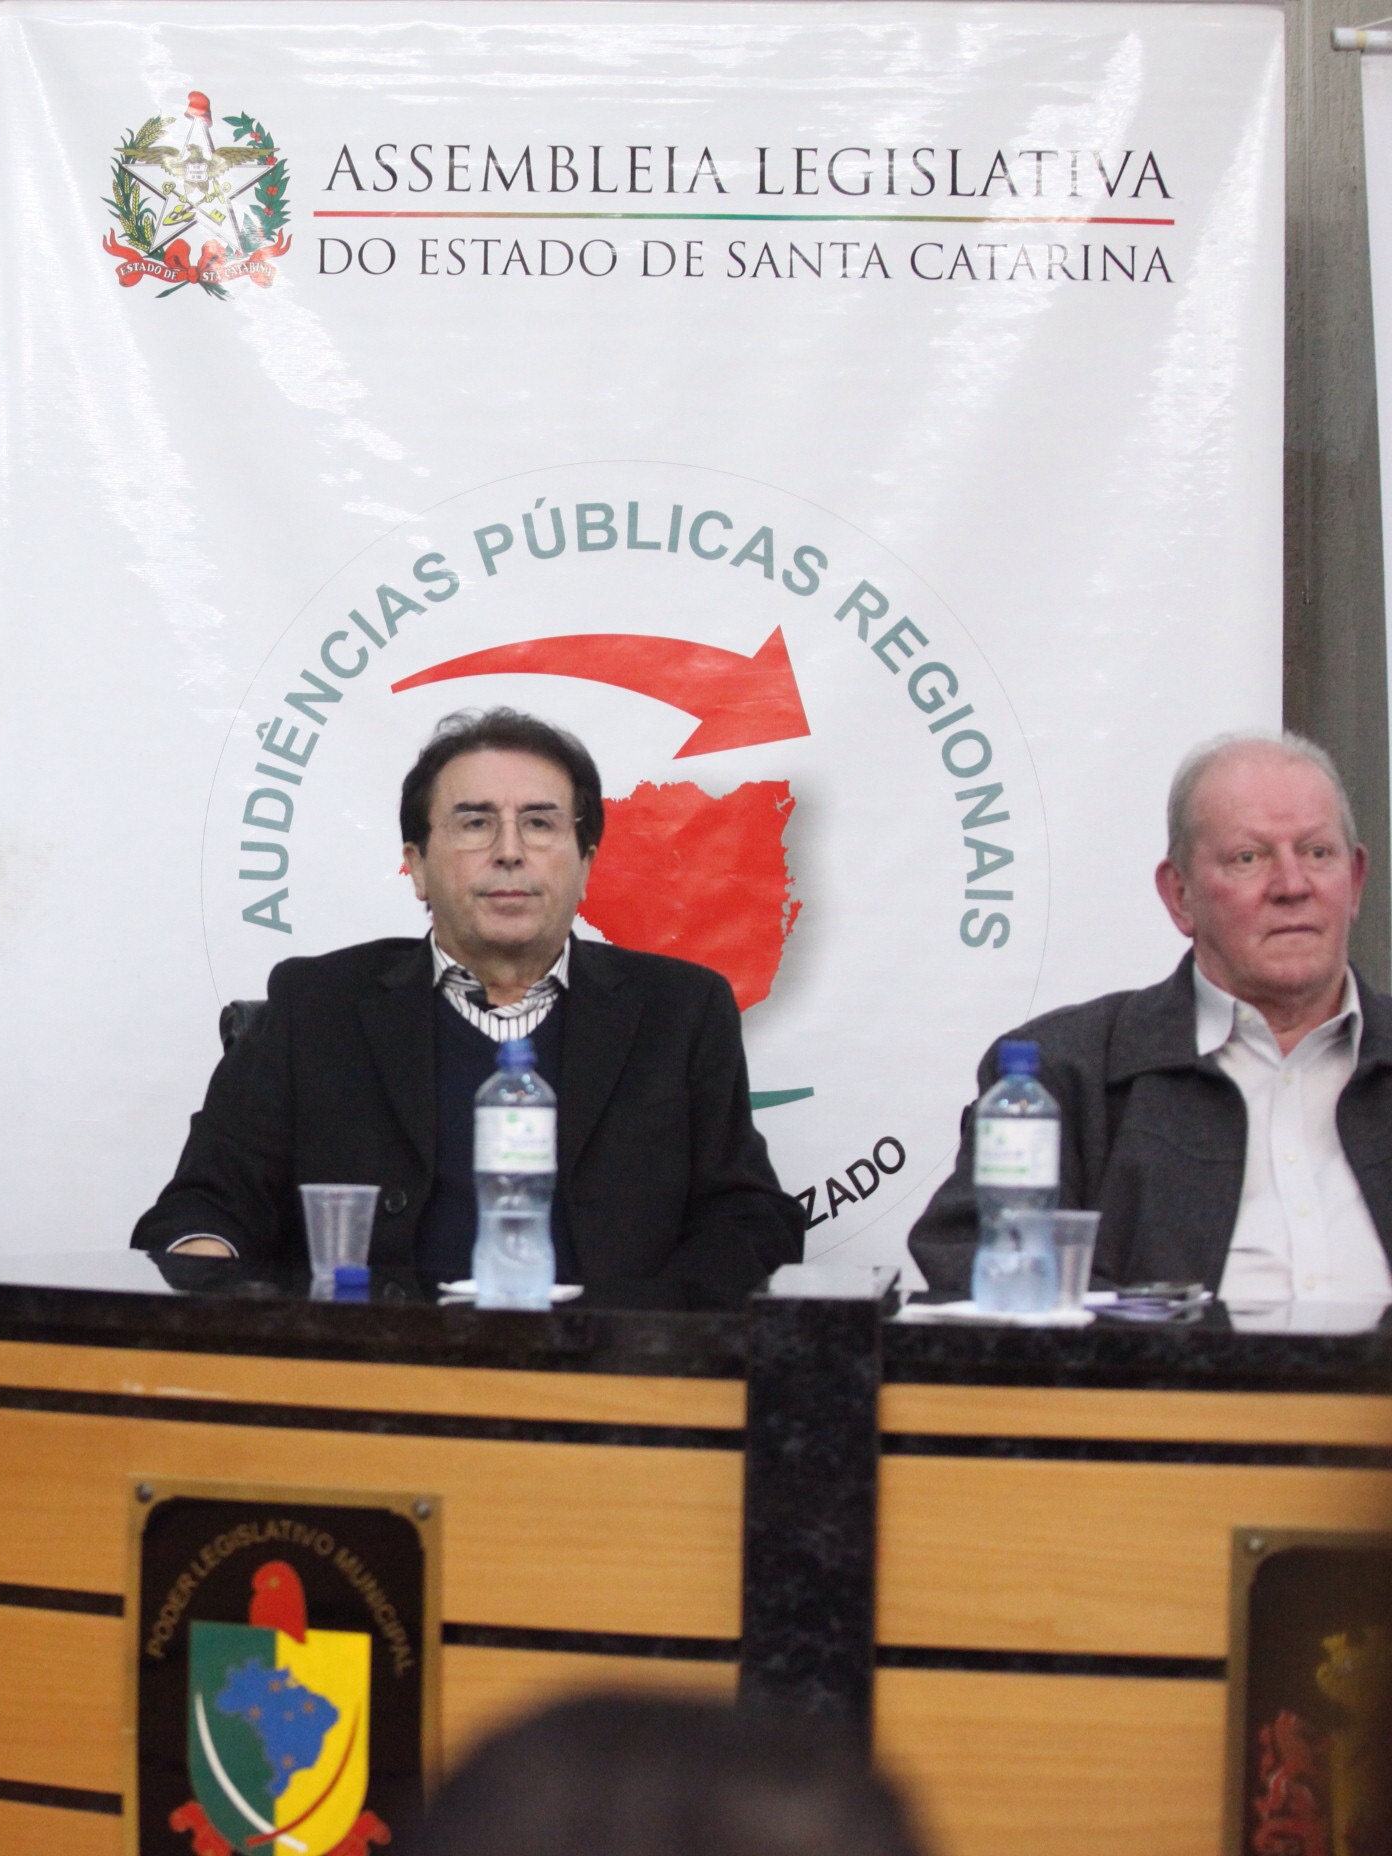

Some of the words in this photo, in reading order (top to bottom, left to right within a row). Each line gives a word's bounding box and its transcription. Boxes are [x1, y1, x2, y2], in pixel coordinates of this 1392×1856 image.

[322, 143, 730, 194] ASSEMBLEIA
[755, 146, 1175, 199] LEGISLATIVA
[120, 262, 162, 276] ESTADO
[163, 268, 179, 280] DE
[317, 237, 396, 276] DO
[419, 238, 618, 277] ESTADO
[641, 240, 704, 278] DE
[726, 240, 893, 279] SANTA
[909, 242, 1176, 283] CATARINA
[238, 549, 462, 935] AUDIÊNCIAS
[473, 497, 829, 596] PÚBLICAS
[834, 579, 1015, 949] REGIONAIS
[145, 1572, 200, 1660] PODER
[190, 1520, 336, 1581] LEGISLATIVO
[333, 1546, 415, 1679] MUNICIPAL
